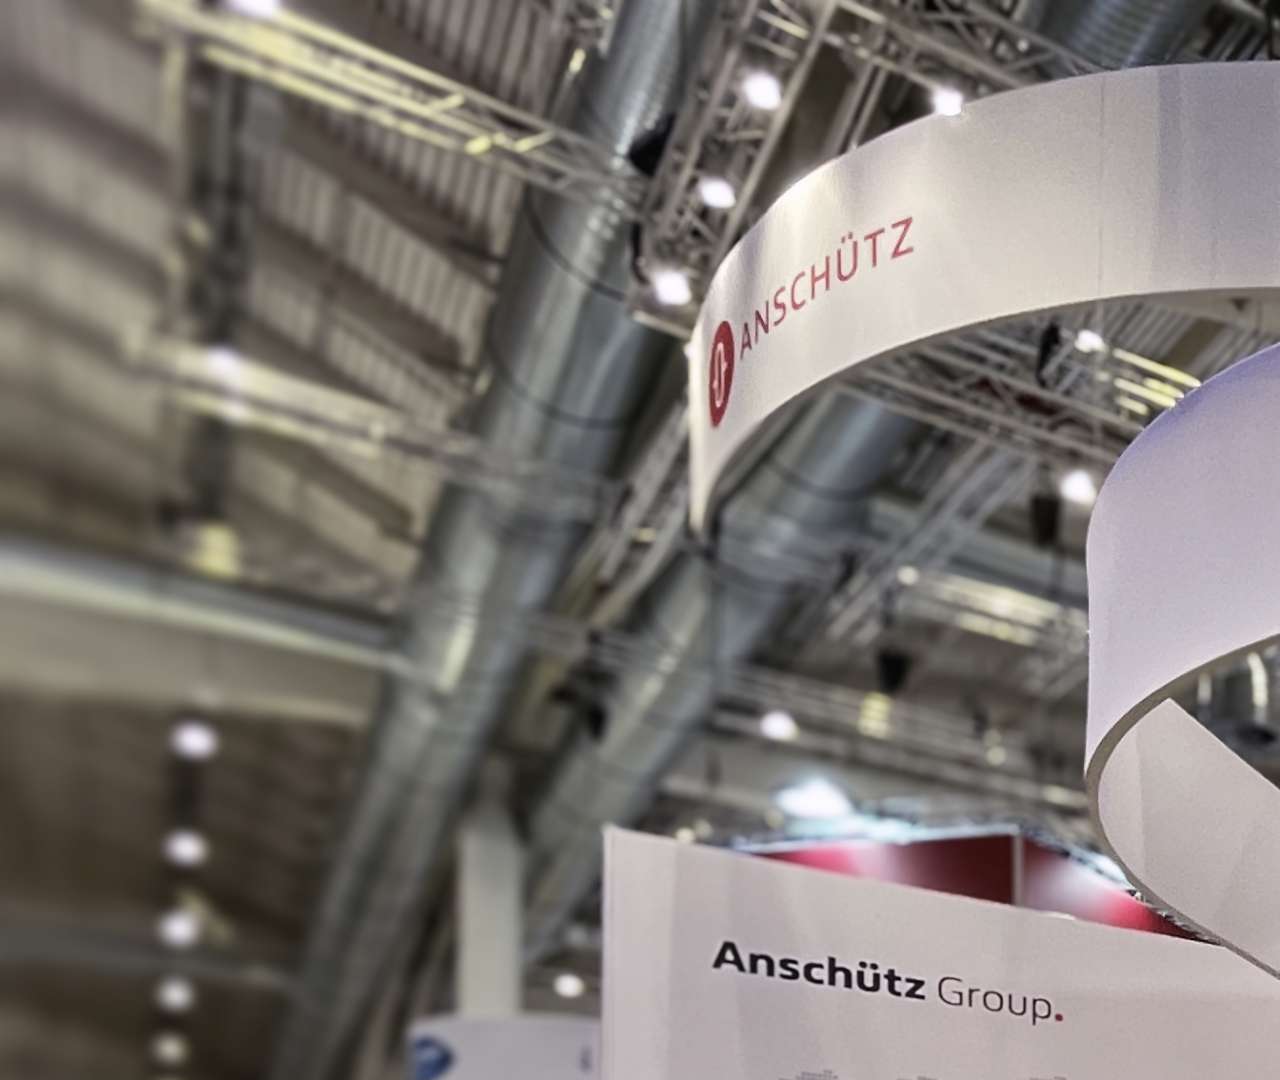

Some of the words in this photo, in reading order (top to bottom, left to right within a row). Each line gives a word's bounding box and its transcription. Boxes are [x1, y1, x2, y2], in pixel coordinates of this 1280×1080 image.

[740, 217, 914, 360] ANSCHÜTZ
[711, 940, 926, 1001] Anschütz
[936, 976, 1065, 1026] Group.
